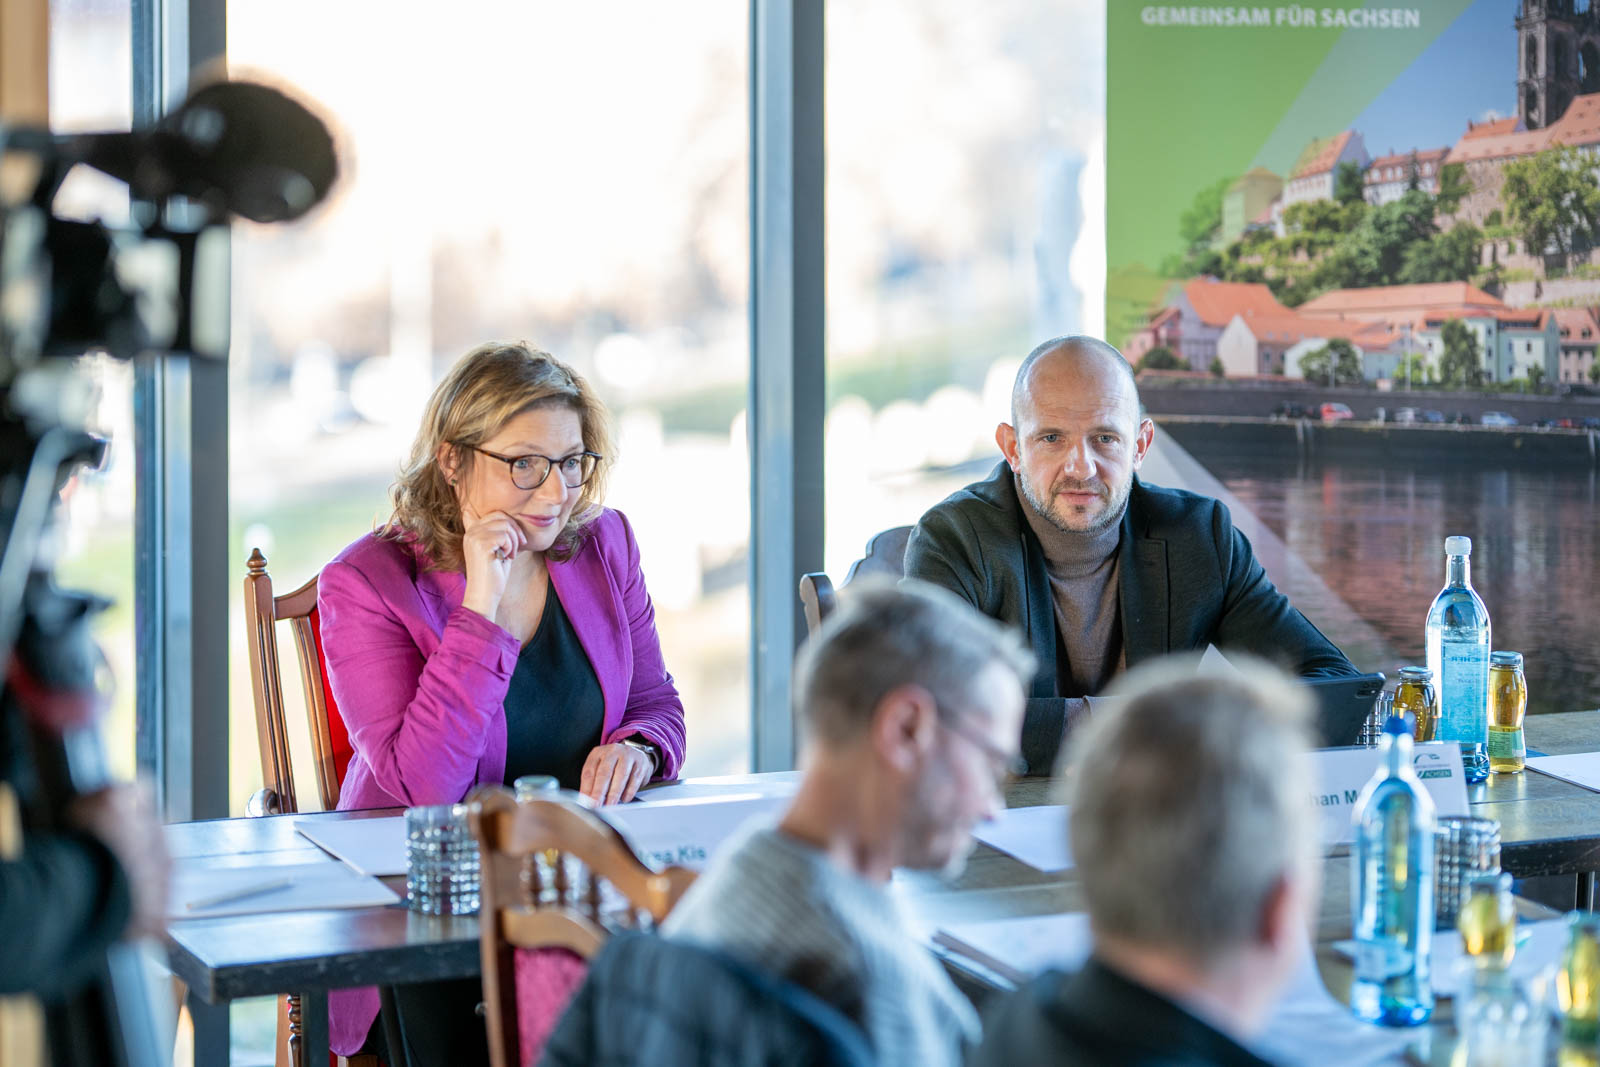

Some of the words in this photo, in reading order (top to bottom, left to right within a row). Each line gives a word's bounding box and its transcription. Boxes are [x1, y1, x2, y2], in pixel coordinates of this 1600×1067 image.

[1141, 6, 1271, 26] GEMEINSAM
[1275, 3, 1317, 26] FÜR
[1321, 7, 1420, 28] SACHSEN
